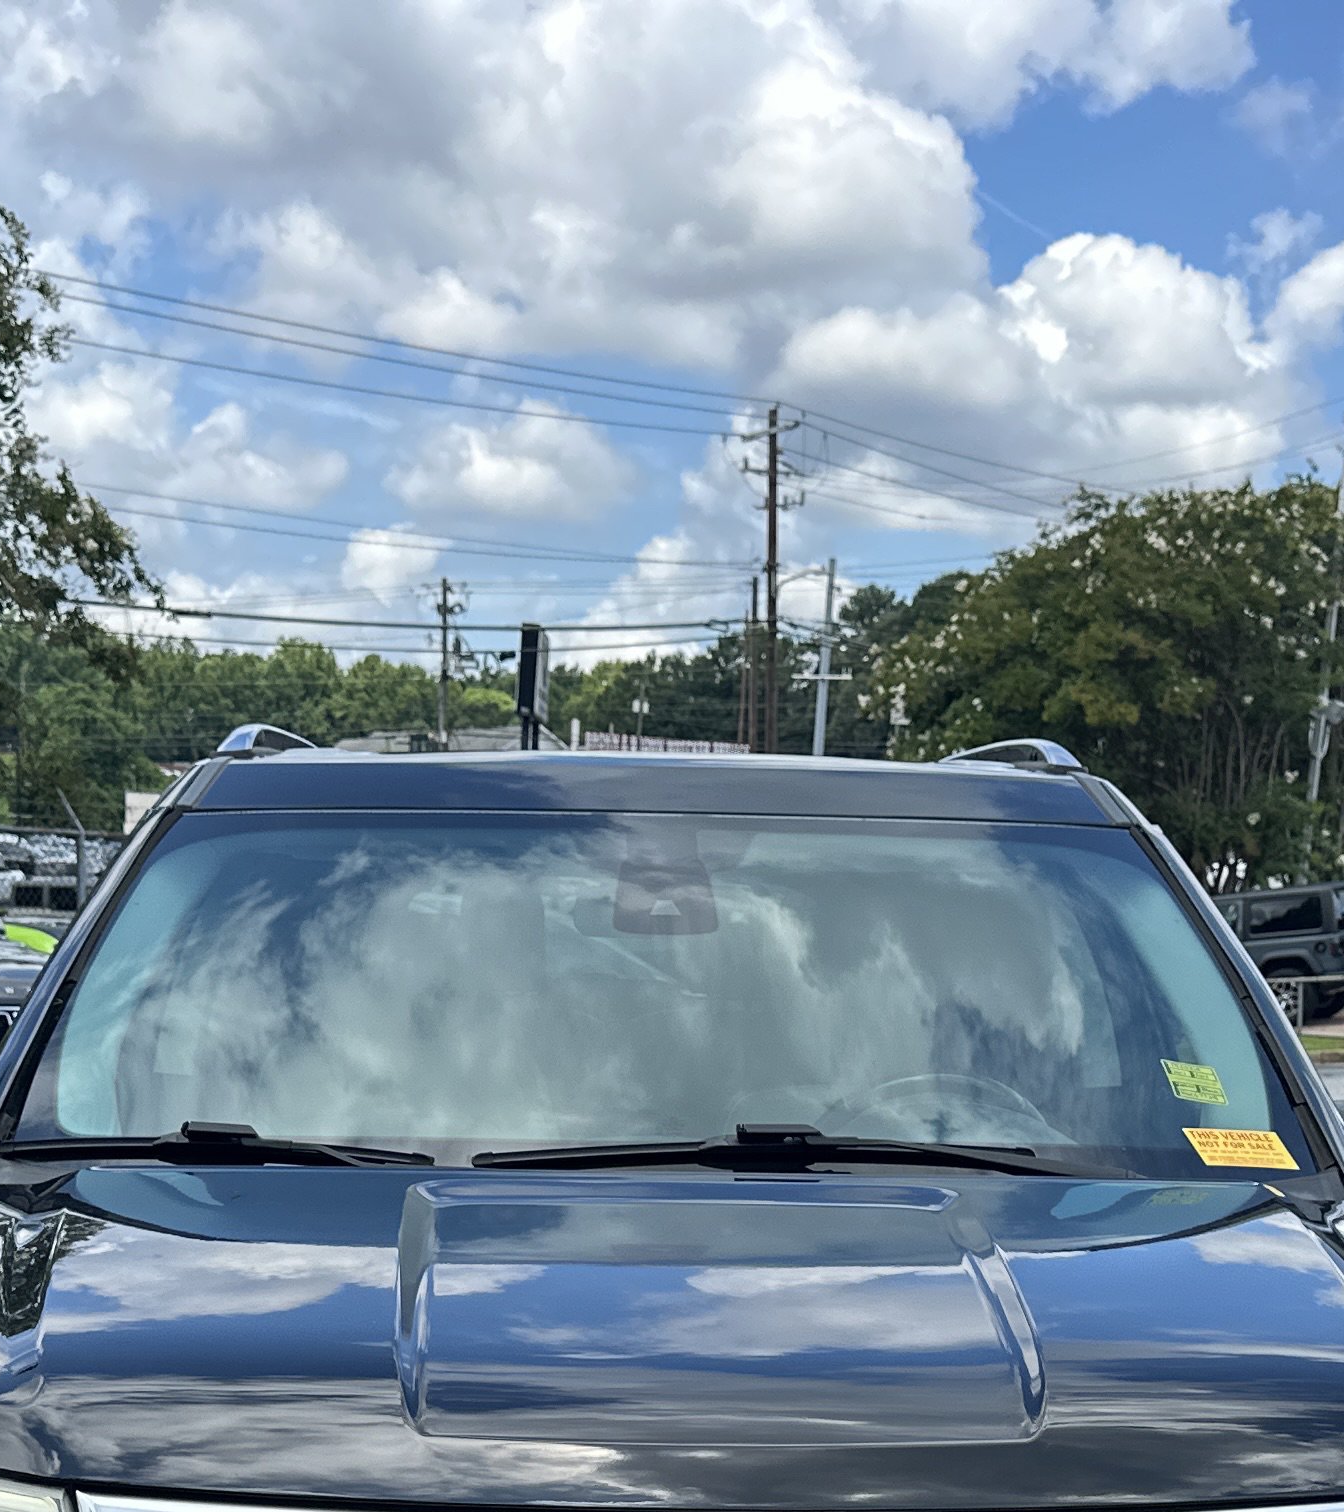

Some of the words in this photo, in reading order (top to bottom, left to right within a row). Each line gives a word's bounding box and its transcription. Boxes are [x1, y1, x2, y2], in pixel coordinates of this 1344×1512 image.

[1188, 1130, 1219, 1140] THIS
[1219, 1131, 1273, 1142] VEHICLE
[1197, 1140, 1220, 1148] NOT
[1223, 1141, 1246, 1149] FOR
[1248, 1142, 1277, 1151] SALE
